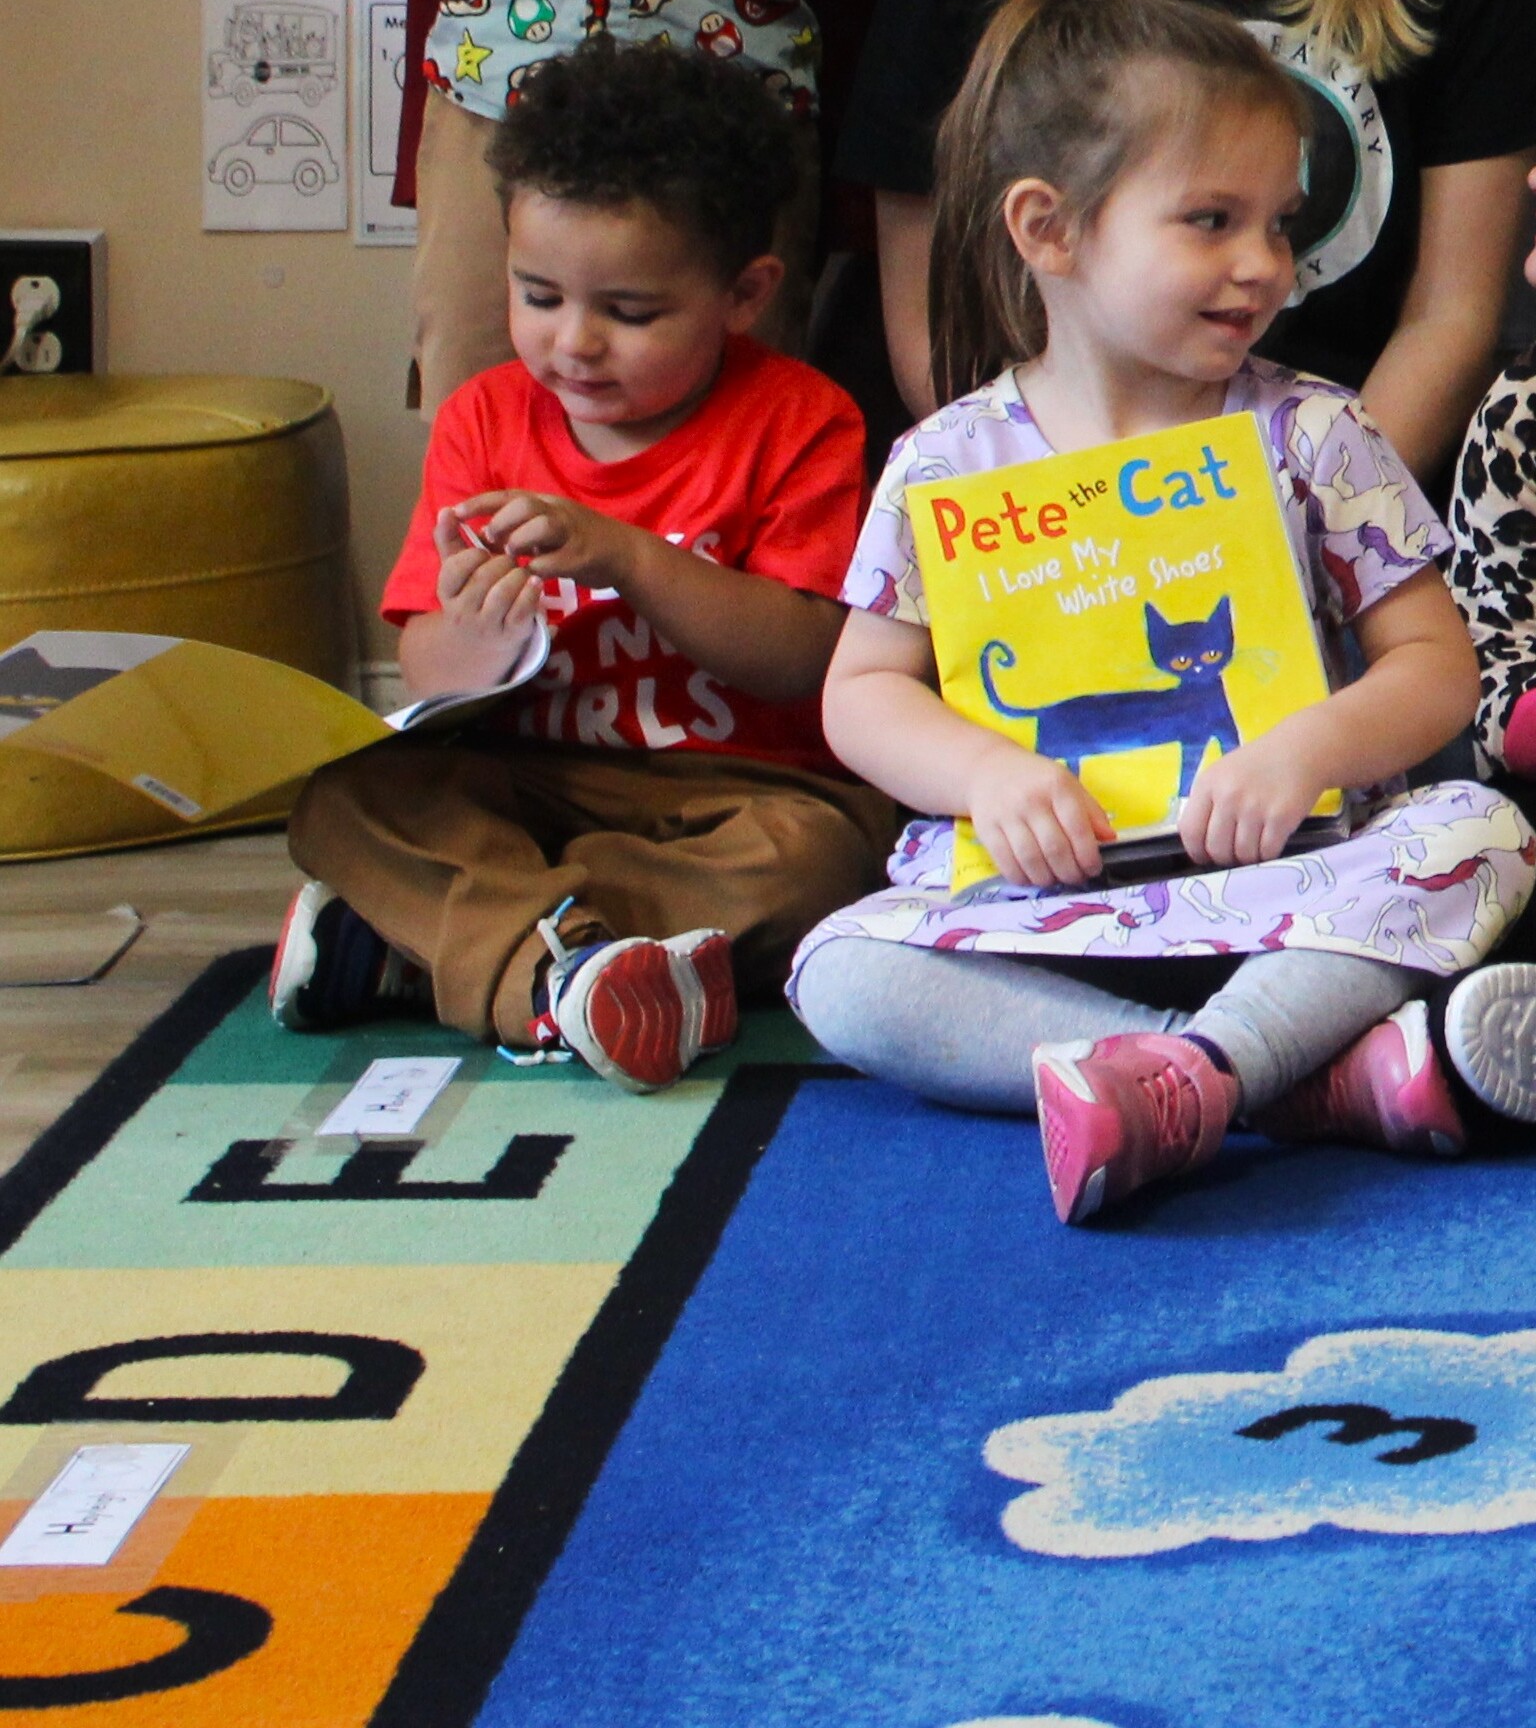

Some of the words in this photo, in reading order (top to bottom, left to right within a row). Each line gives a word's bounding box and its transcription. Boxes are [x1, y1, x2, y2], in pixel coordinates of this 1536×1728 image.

[931, 491, 1069, 561] Pete
[1070, 477, 1108, 509] the
[1117, 445, 1237, 517] Cat
[978, 573, 990, 602] I
[1000, 559, 1061, 596] Love
[1071, 536, 1122, 573] My
[1057, 574, 1137, 615] White
[1149, 544, 1225, 589] Shoes
[181, 1133, 576, 1204] E
[0, 1330, 427, 1425] D
[1234, 1403, 1478, 1466] 3
[0, 1584, 274, 1710] C
